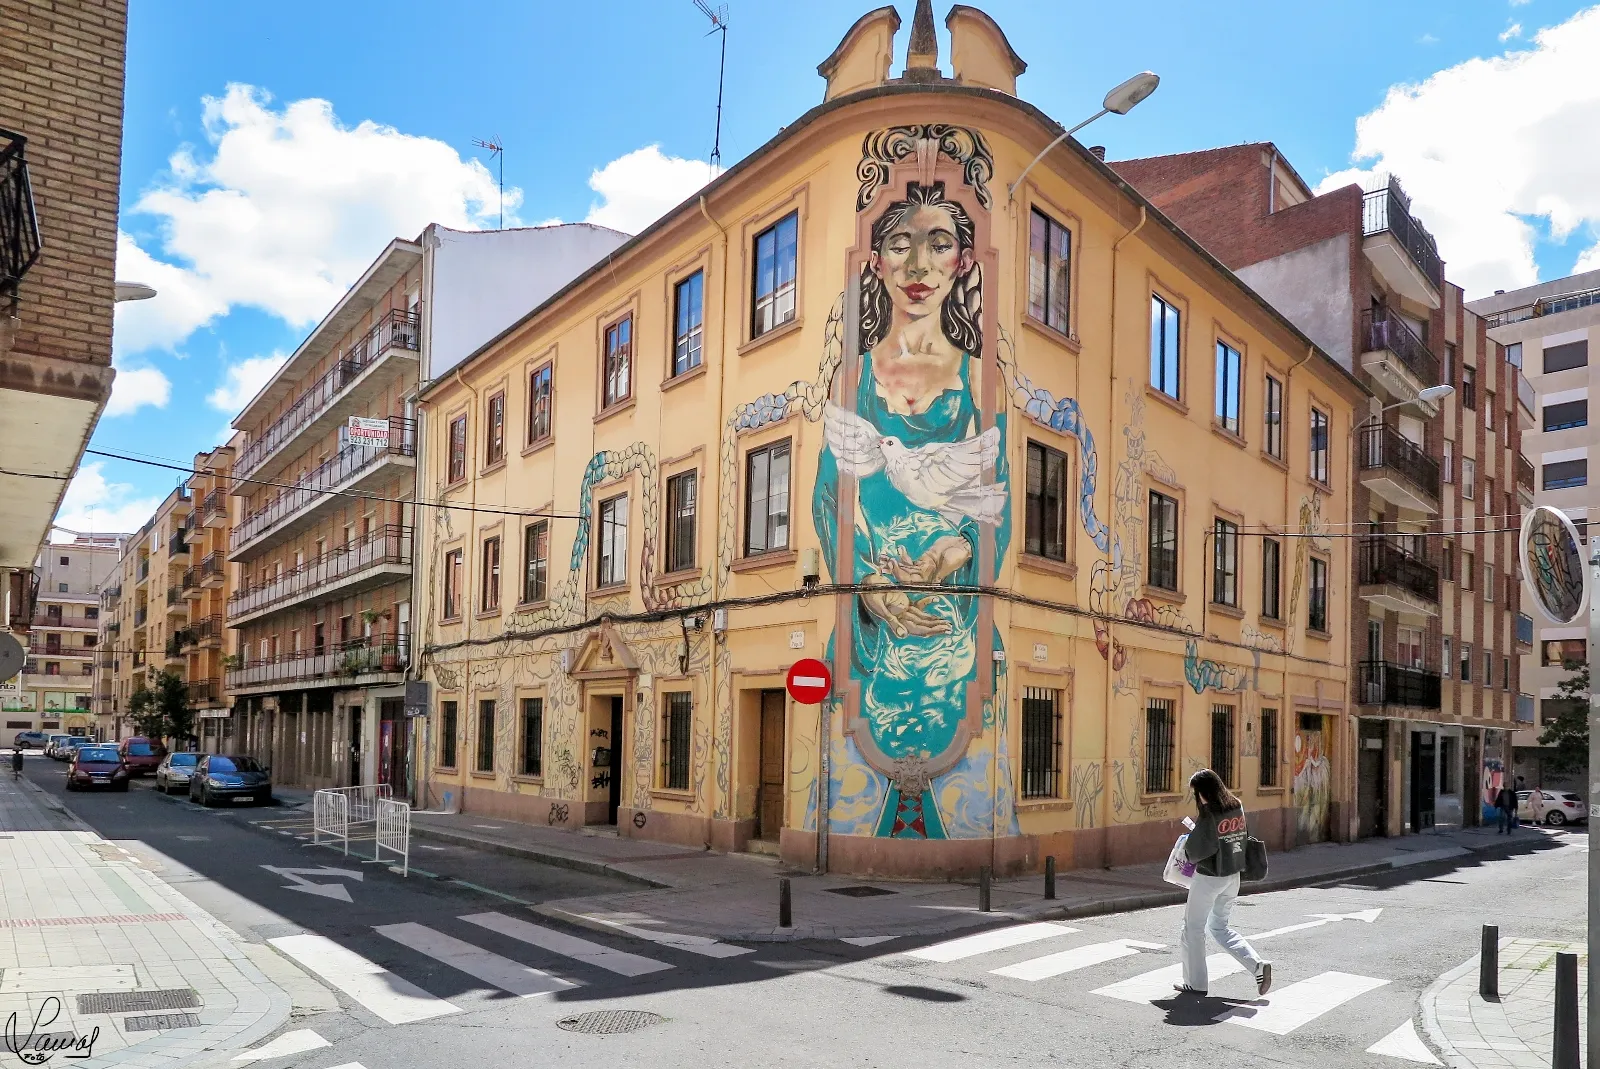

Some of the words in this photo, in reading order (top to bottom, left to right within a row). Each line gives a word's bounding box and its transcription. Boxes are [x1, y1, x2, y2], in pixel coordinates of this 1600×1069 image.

[350, 436, 362, 444] 923
[363, 438, 374, 446] 231
[375, 439, 388, 447] 712
